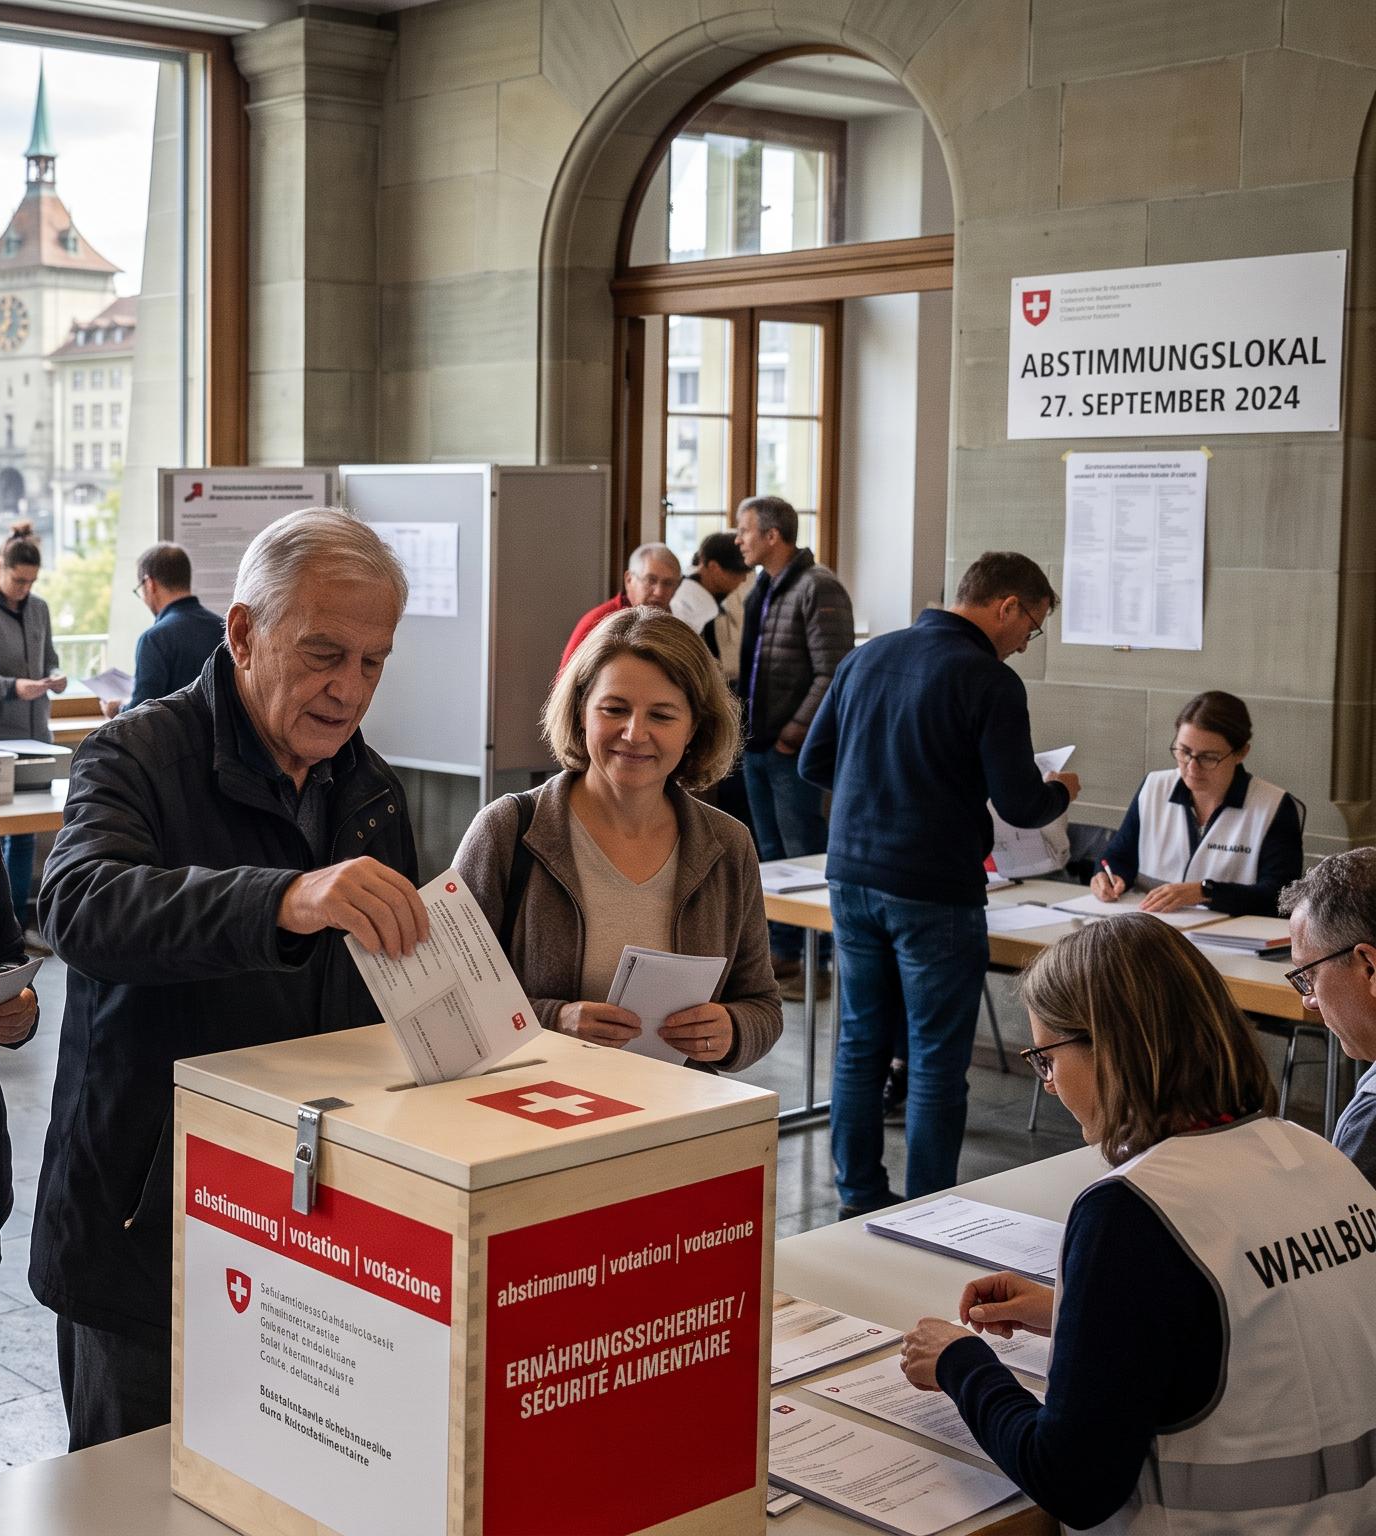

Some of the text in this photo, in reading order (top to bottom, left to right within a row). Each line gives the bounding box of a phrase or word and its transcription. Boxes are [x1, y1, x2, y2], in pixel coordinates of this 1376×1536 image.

[1021, 336, 1327, 379] ABSTIMMUNGSLOKAL
[1039, 385, 1301, 418] 27. SEPTEMBER 2024
[195, 1186, 279, 1241] abstimmung
[289, 1226, 350, 1266] votation
[363, 1256, 442, 1304] votazione
[497, 1263, 597, 1307] abstimmung
[609, 1243, 671, 1275] votation
[683, 1220, 754, 1255] votazione
[506, 1295, 735, 1388] ERNÄHRUNGSSICHERHEIT
[520, 1363, 609, 1419] SÉCURITÉ
[612, 1330, 731, 1391] ALIMENTAIRE
